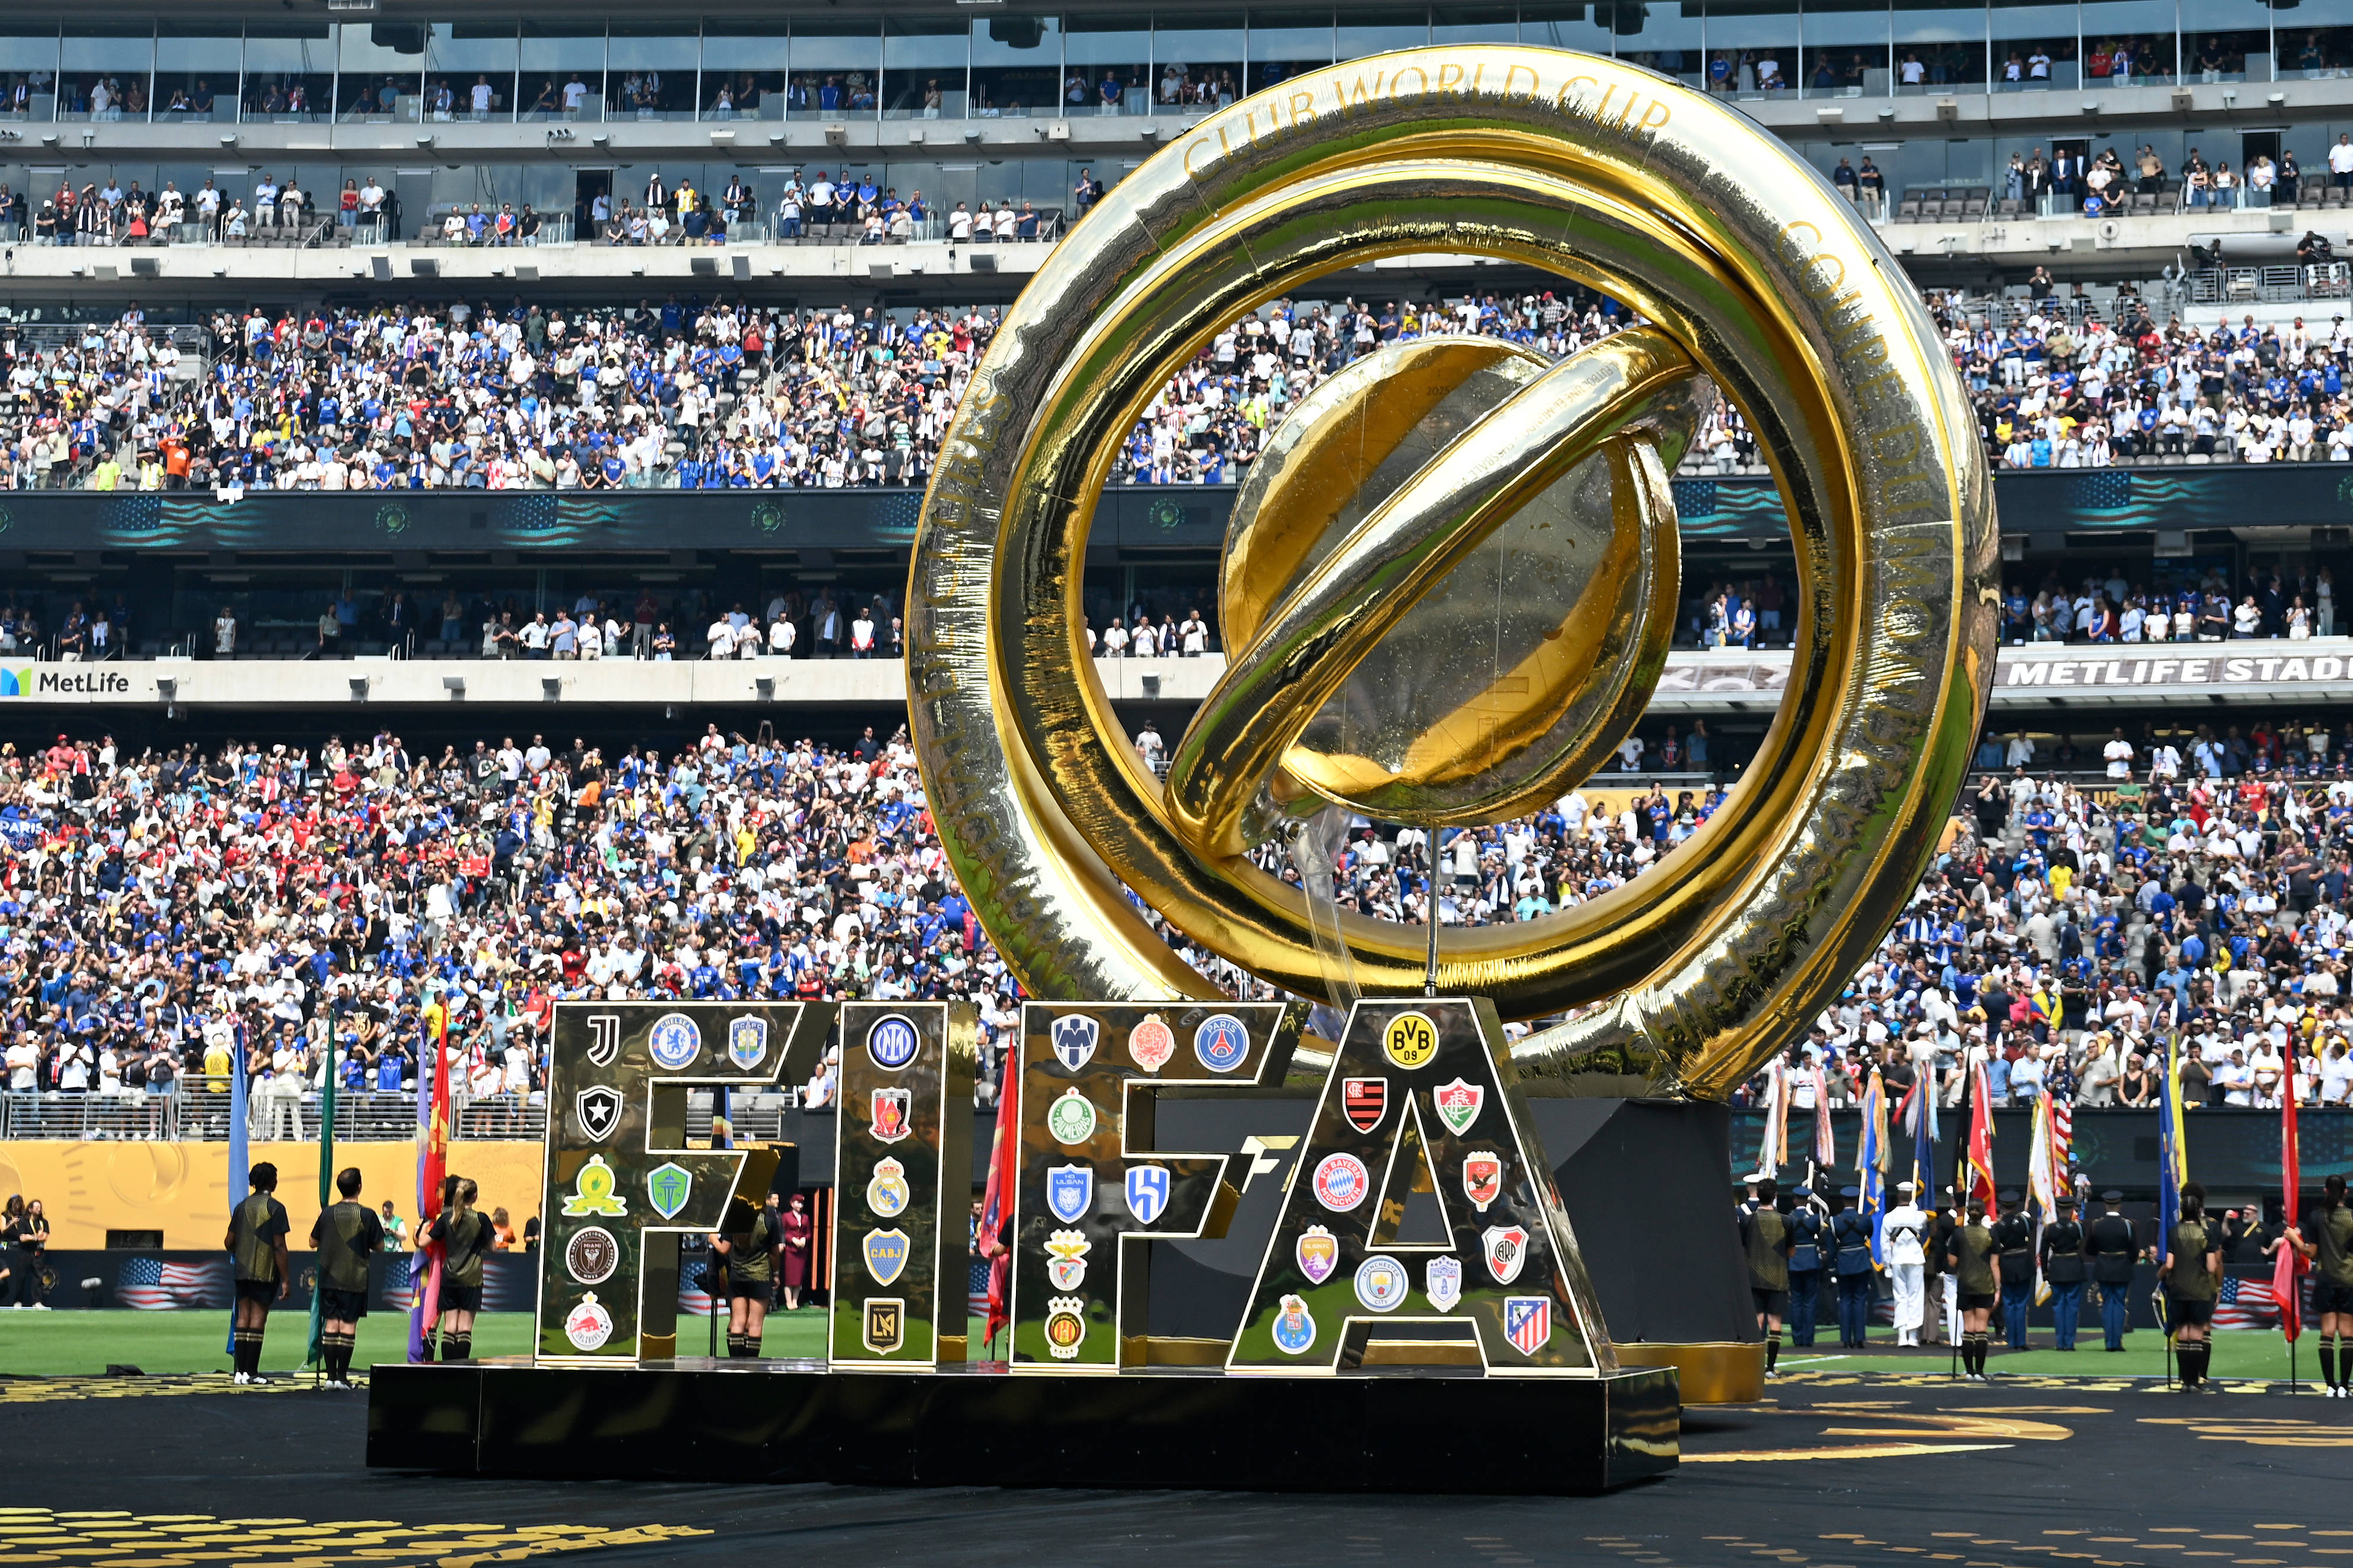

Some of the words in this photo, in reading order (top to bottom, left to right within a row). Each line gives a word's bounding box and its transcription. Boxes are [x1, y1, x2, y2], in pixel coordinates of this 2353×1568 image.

[1183, 92, 1318, 182] CLUB
[1333, 63, 1540, 119] WORLD
[1557, 75, 1672, 142] CUP
[1777, 221, 1906, 412] COUPE
[1872, 422, 1933, 516] DU
[1426, 386, 1450, 397] 2025
[919, 387, 1012, 607] CLUBES
[39, 672, 129, 694] MetLife
[2007, 659, 2210, 686] METLIFE
[661, 1017, 691, 1030] CHELSEA
[1206, 1021, 1237, 1033] PARIS
[1394, 1020, 1430, 1050] BVB
[1403, 1050, 1417, 1060] 09
[1054, 1116, 1091, 1138] PALMEIRAS
[1320, 1167, 1330, 1179] FC
[1330, 1160, 1361, 1178] BAYERN
[537, 998, 1605, 1376] FIFA
[871, 1248, 901, 1258] CABJ
[1363, 1262, 1400, 1277] MANCHESTER
